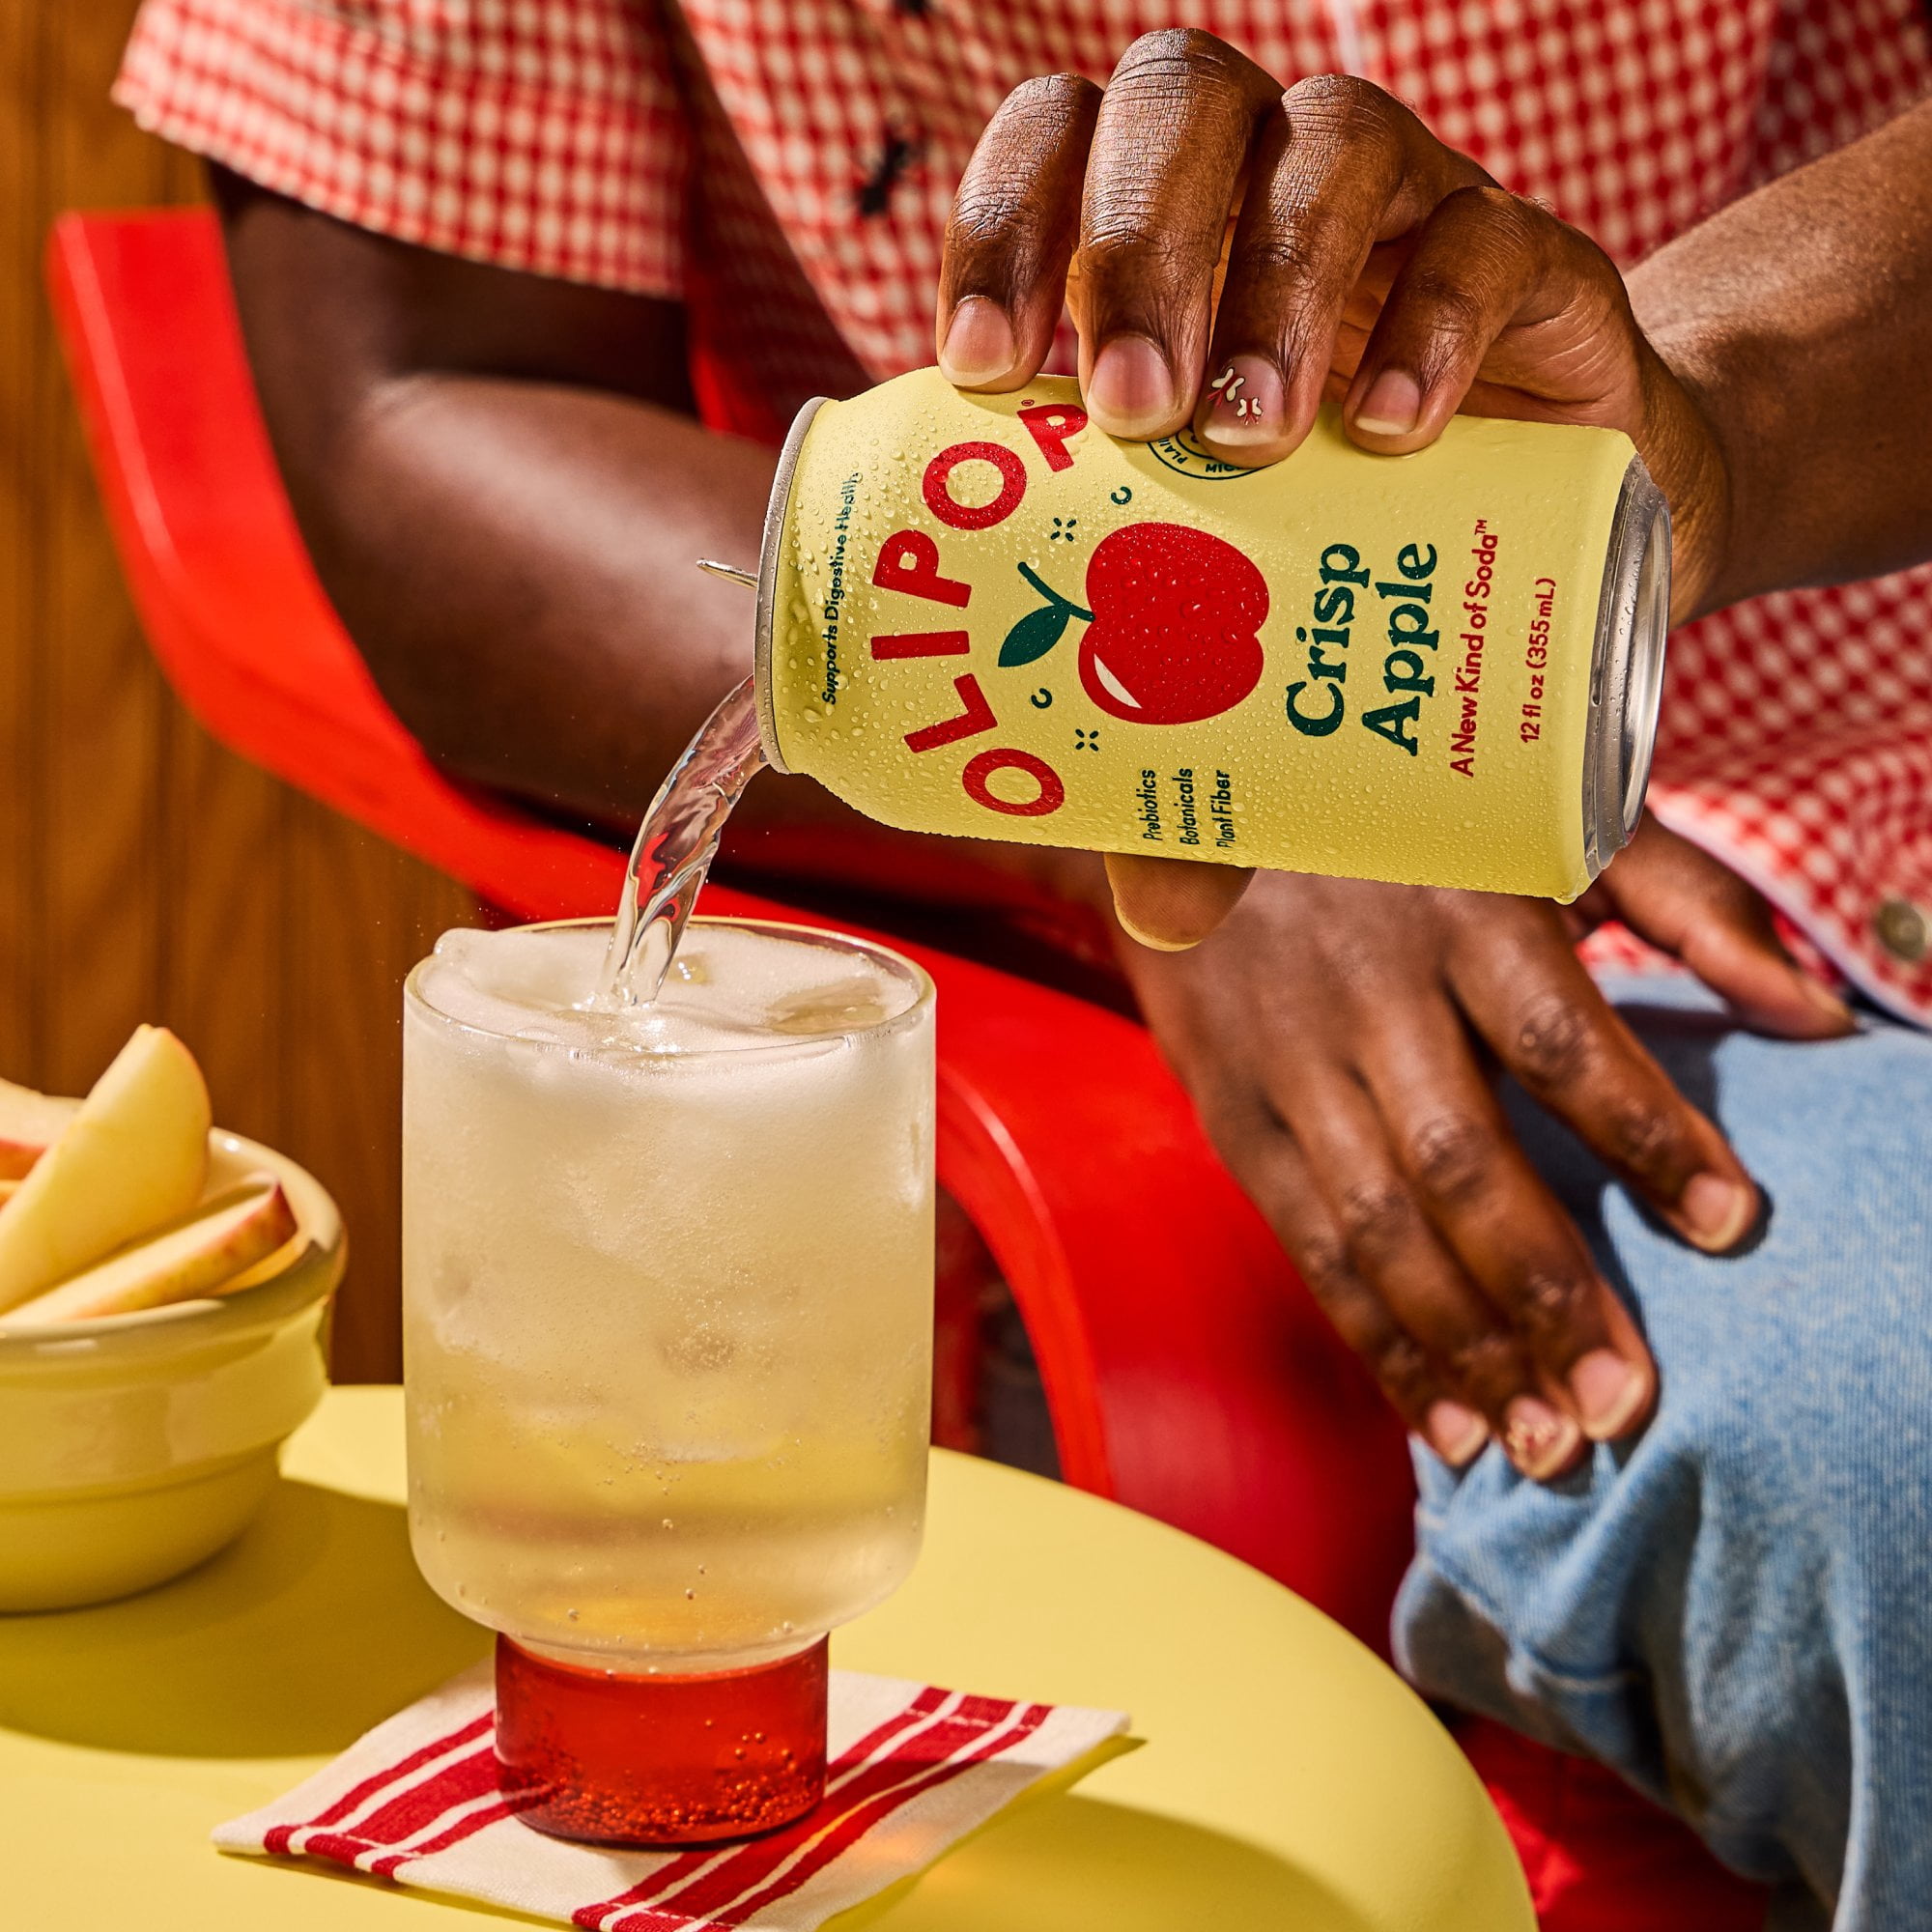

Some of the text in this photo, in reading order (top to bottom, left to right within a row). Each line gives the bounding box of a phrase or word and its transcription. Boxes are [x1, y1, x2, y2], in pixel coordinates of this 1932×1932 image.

[825, 534, 846, 620] Digestive
[870, 403, 1089, 817] OLIPOP
[1286, 543, 1371, 737] Crisp
[1361, 543, 1439, 756] Apple
[1463, 602, 1488, 629] of
[822, 625, 840, 705] Supports
[1455, 634, 1484, 693] Kind
[1529, 674, 1544, 699] oz
[1451, 696, 1478, 753] New
[1520, 724, 1541, 743] 12
[1522, 703, 1541, 718] fl
[1450, 757, 1474, 778] A
[1136, 769, 1163, 841] Prebiotics
[1172, 768, 1200, 845] Botanicals
[1209, 769, 1236, 848] Plant Fiber
